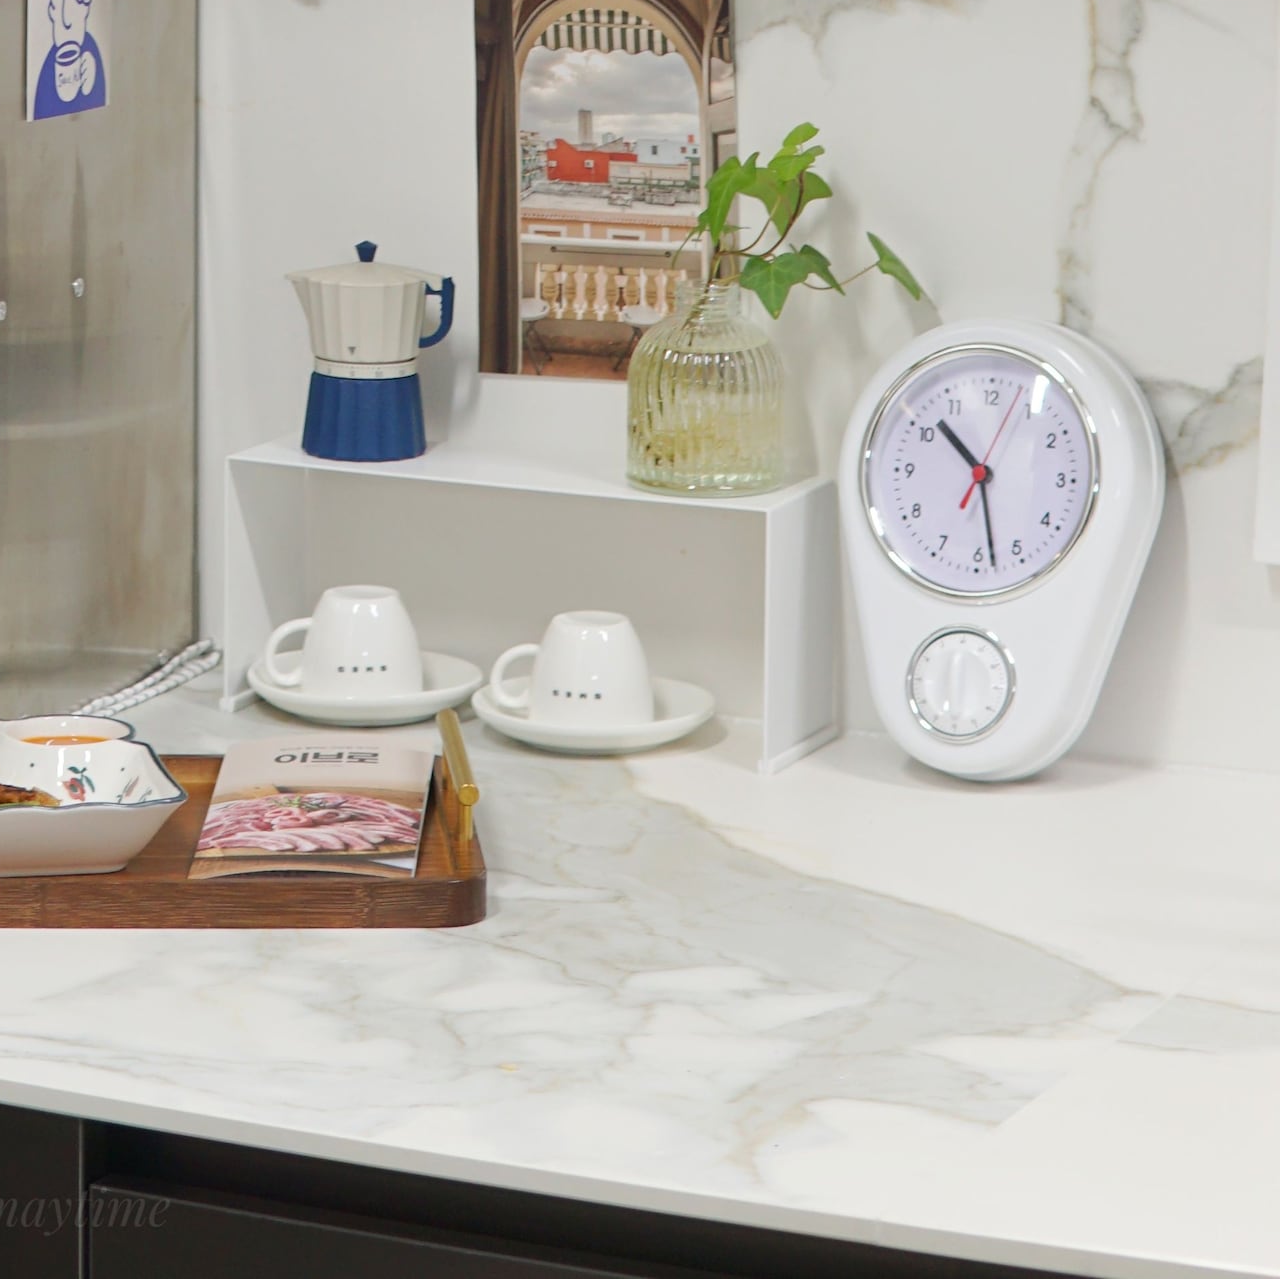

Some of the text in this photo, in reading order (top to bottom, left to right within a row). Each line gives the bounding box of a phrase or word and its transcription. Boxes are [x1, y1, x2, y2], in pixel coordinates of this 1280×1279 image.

[983, 389, 1000, 407] 12
[947, 399, 962, 416] 11
[919, 426, 936, 443] 10
[1045, 432, 1057, 449] 2
[904, 462, 916, 479] 9
[1055, 472, 1066, 489] 3
[911, 502, 922, 519] 8
[1039, 511, 1051, 528] 4
[938, 534, 949, 551] 7
[1010, 539, 1022, 556] 5
[972, 546, 984, 563] 6
